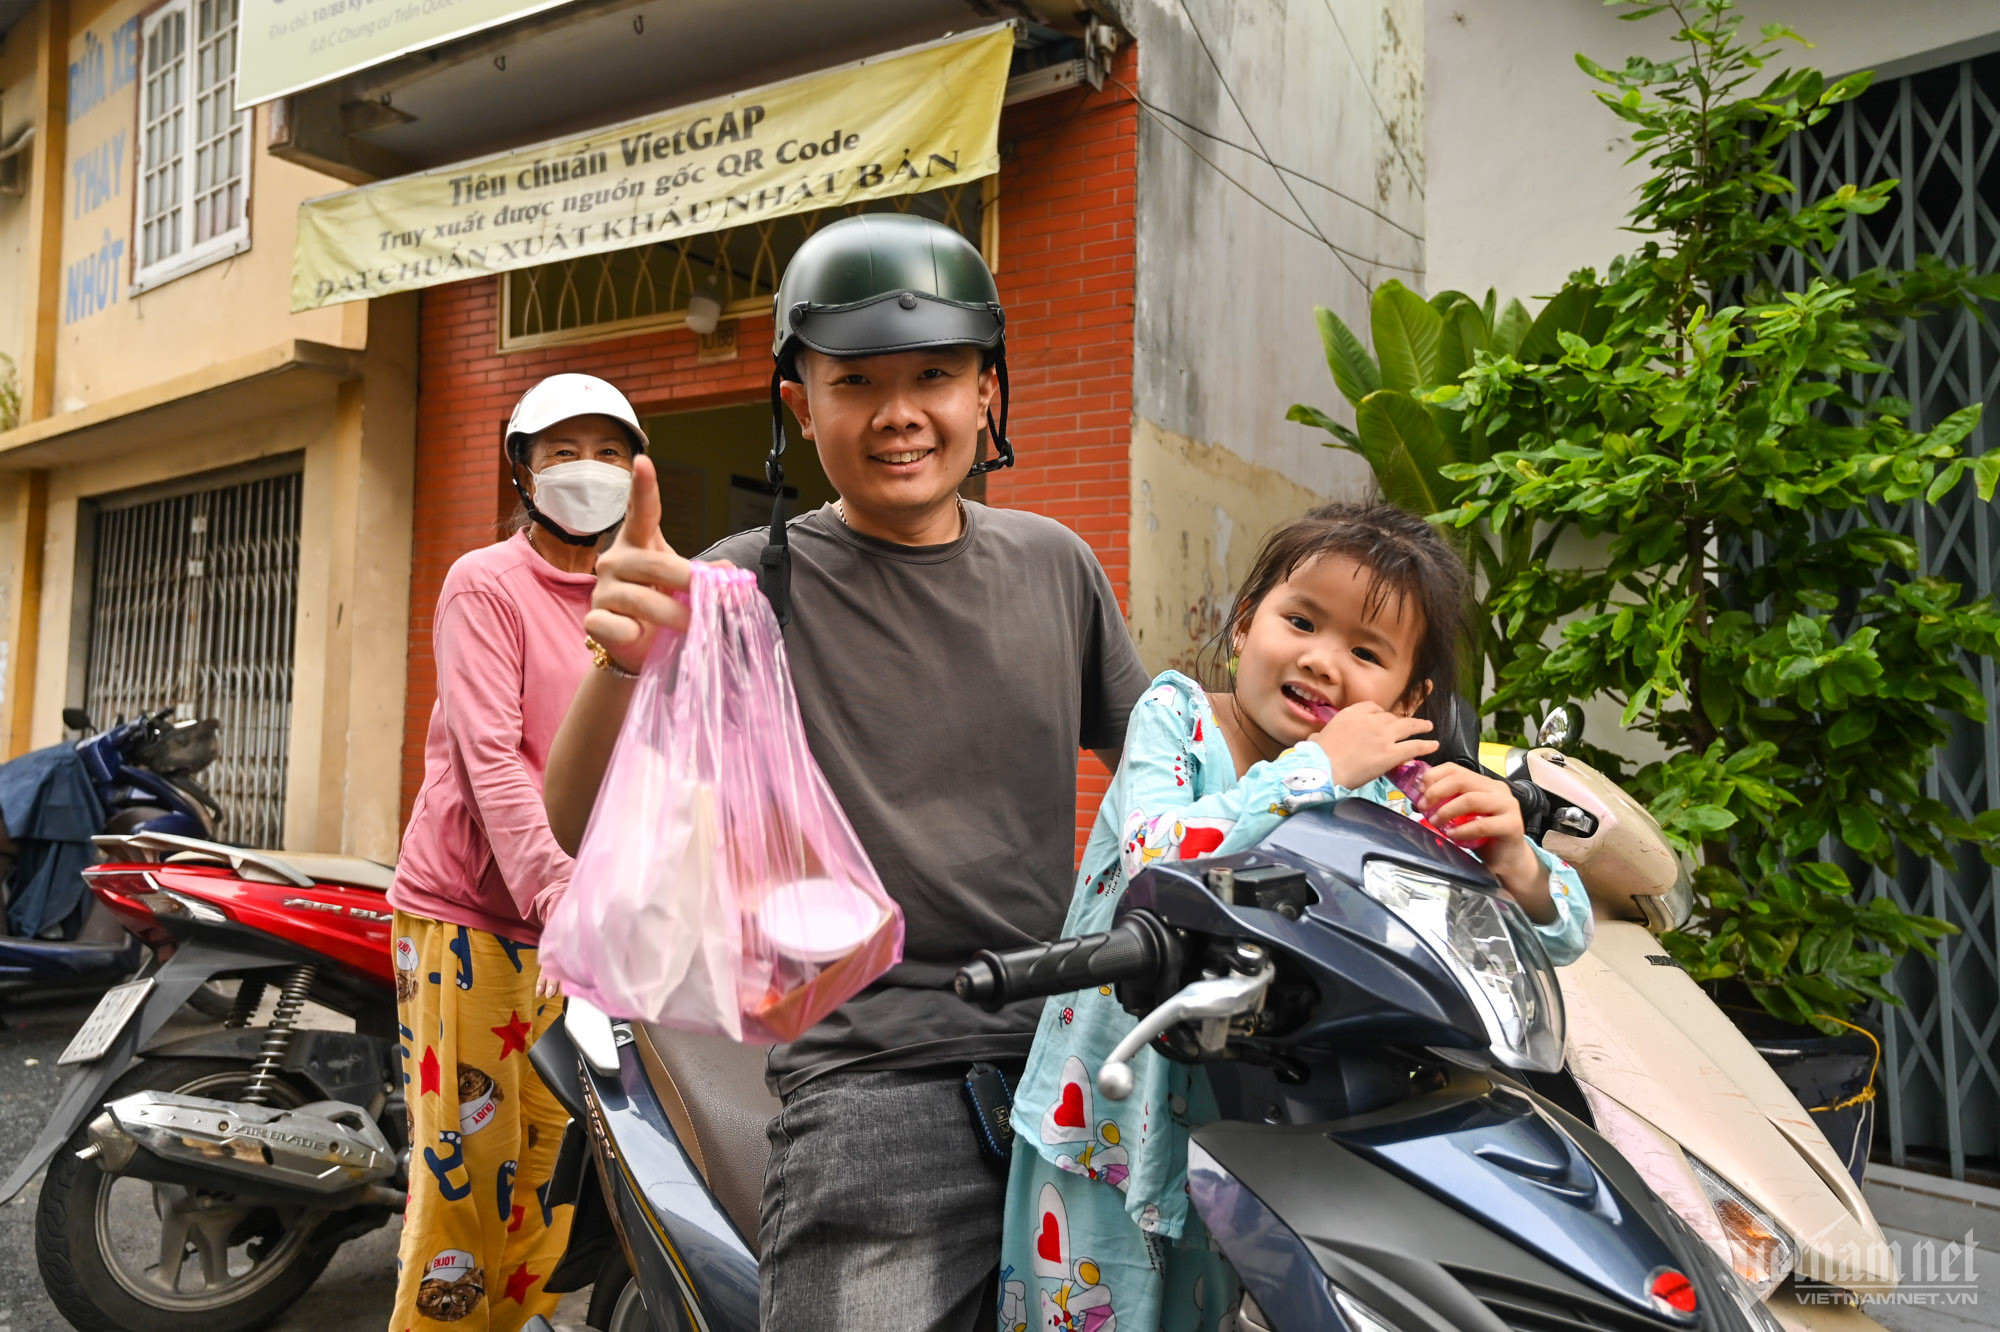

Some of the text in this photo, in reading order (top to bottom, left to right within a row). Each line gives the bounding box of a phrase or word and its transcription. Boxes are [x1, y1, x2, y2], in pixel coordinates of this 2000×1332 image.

[109, 13, 139, 97] XE
[73, 128, 126, 221] THAY
[379, 227, 426, 251] Truy
[434, 211, 487, 240] xuất
[654, 162, 707, 197] gốc
[716, 148, 764, 177] QR
[776, 129, 861, 164] Code
[449, 104, 766, 207] Tiêu chuẩn VietGAP
[496, 223, 593, 264] XUẤT
[723, 169, 845, 218] NHẬT
[856, 148, 960, 190] BẢN
[284, 898, 343, 914] AIR
[269, 1130, 328, 1152] BLADE
[472, 1101, 496, 1125] ENJOY
[433, 1255, 457, 1268] ENJOY
